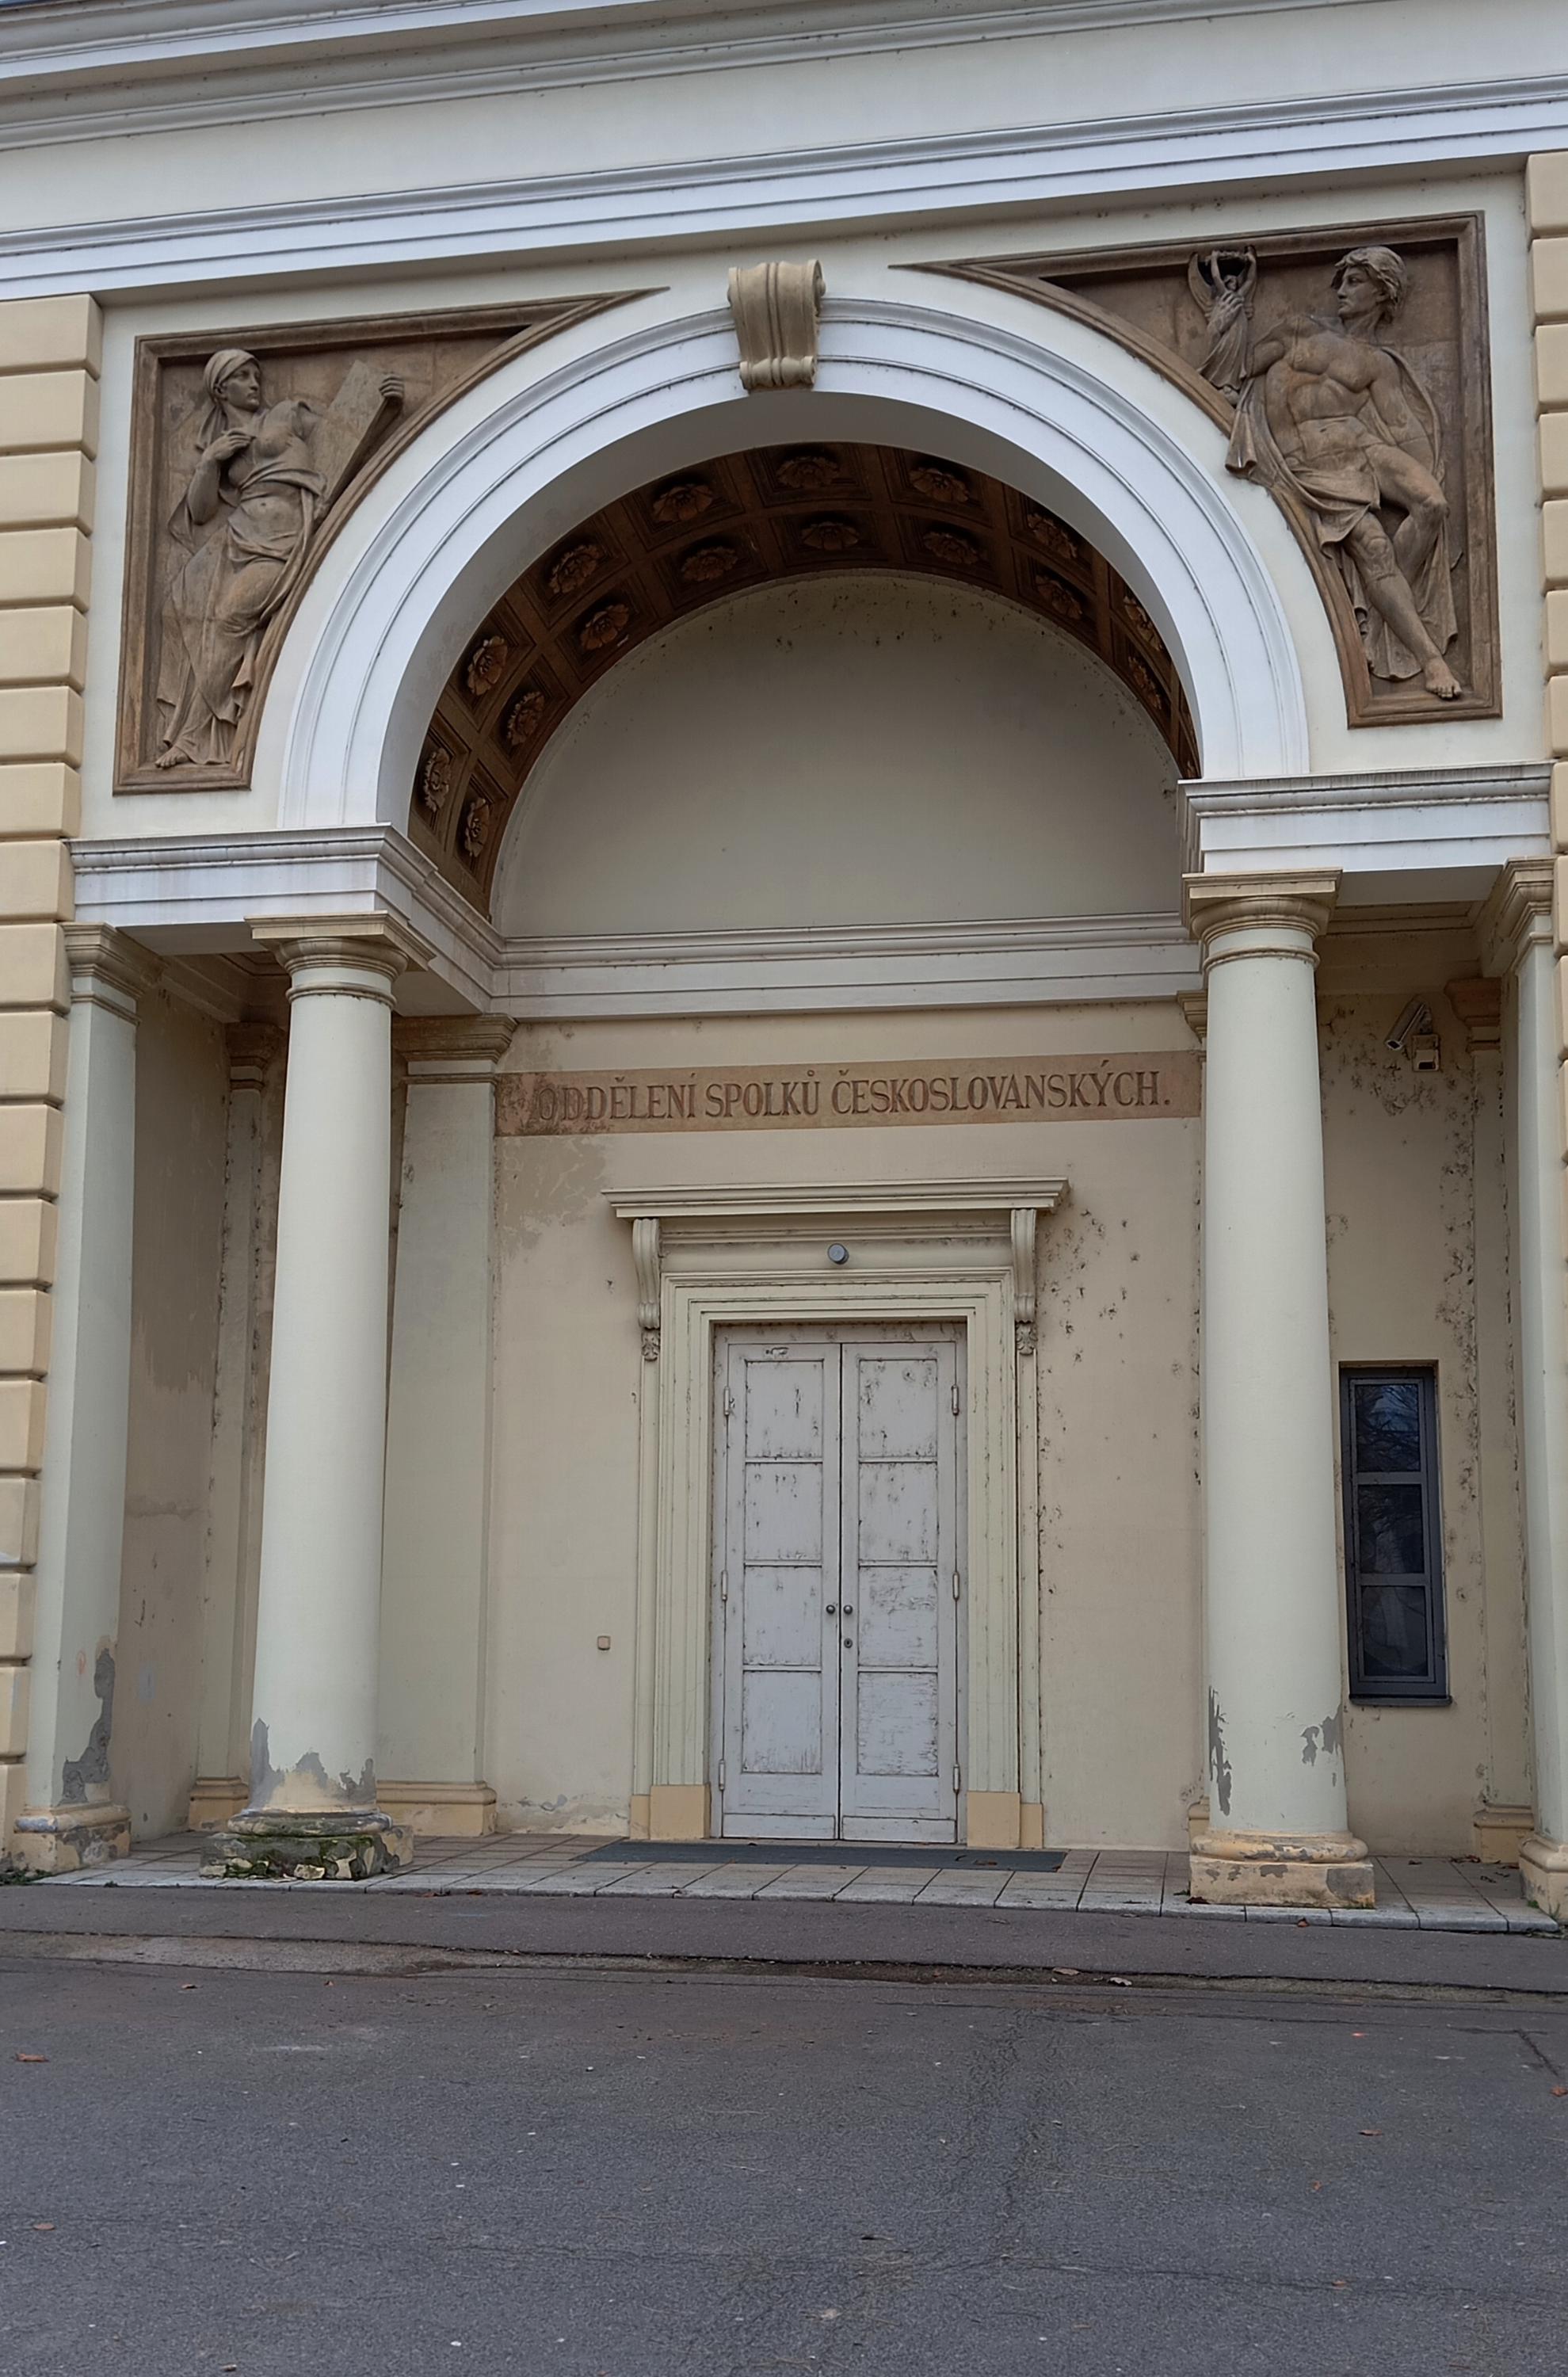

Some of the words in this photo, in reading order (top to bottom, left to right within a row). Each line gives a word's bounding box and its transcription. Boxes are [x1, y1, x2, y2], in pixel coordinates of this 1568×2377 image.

[537, 1072, 698, 1121] ODDĚLENÍ
[704, 1070, 820, 1118] SPOLKŮ
[830, 1060, 1171, 1114] ČESKOSLOVANSKÝCH.
